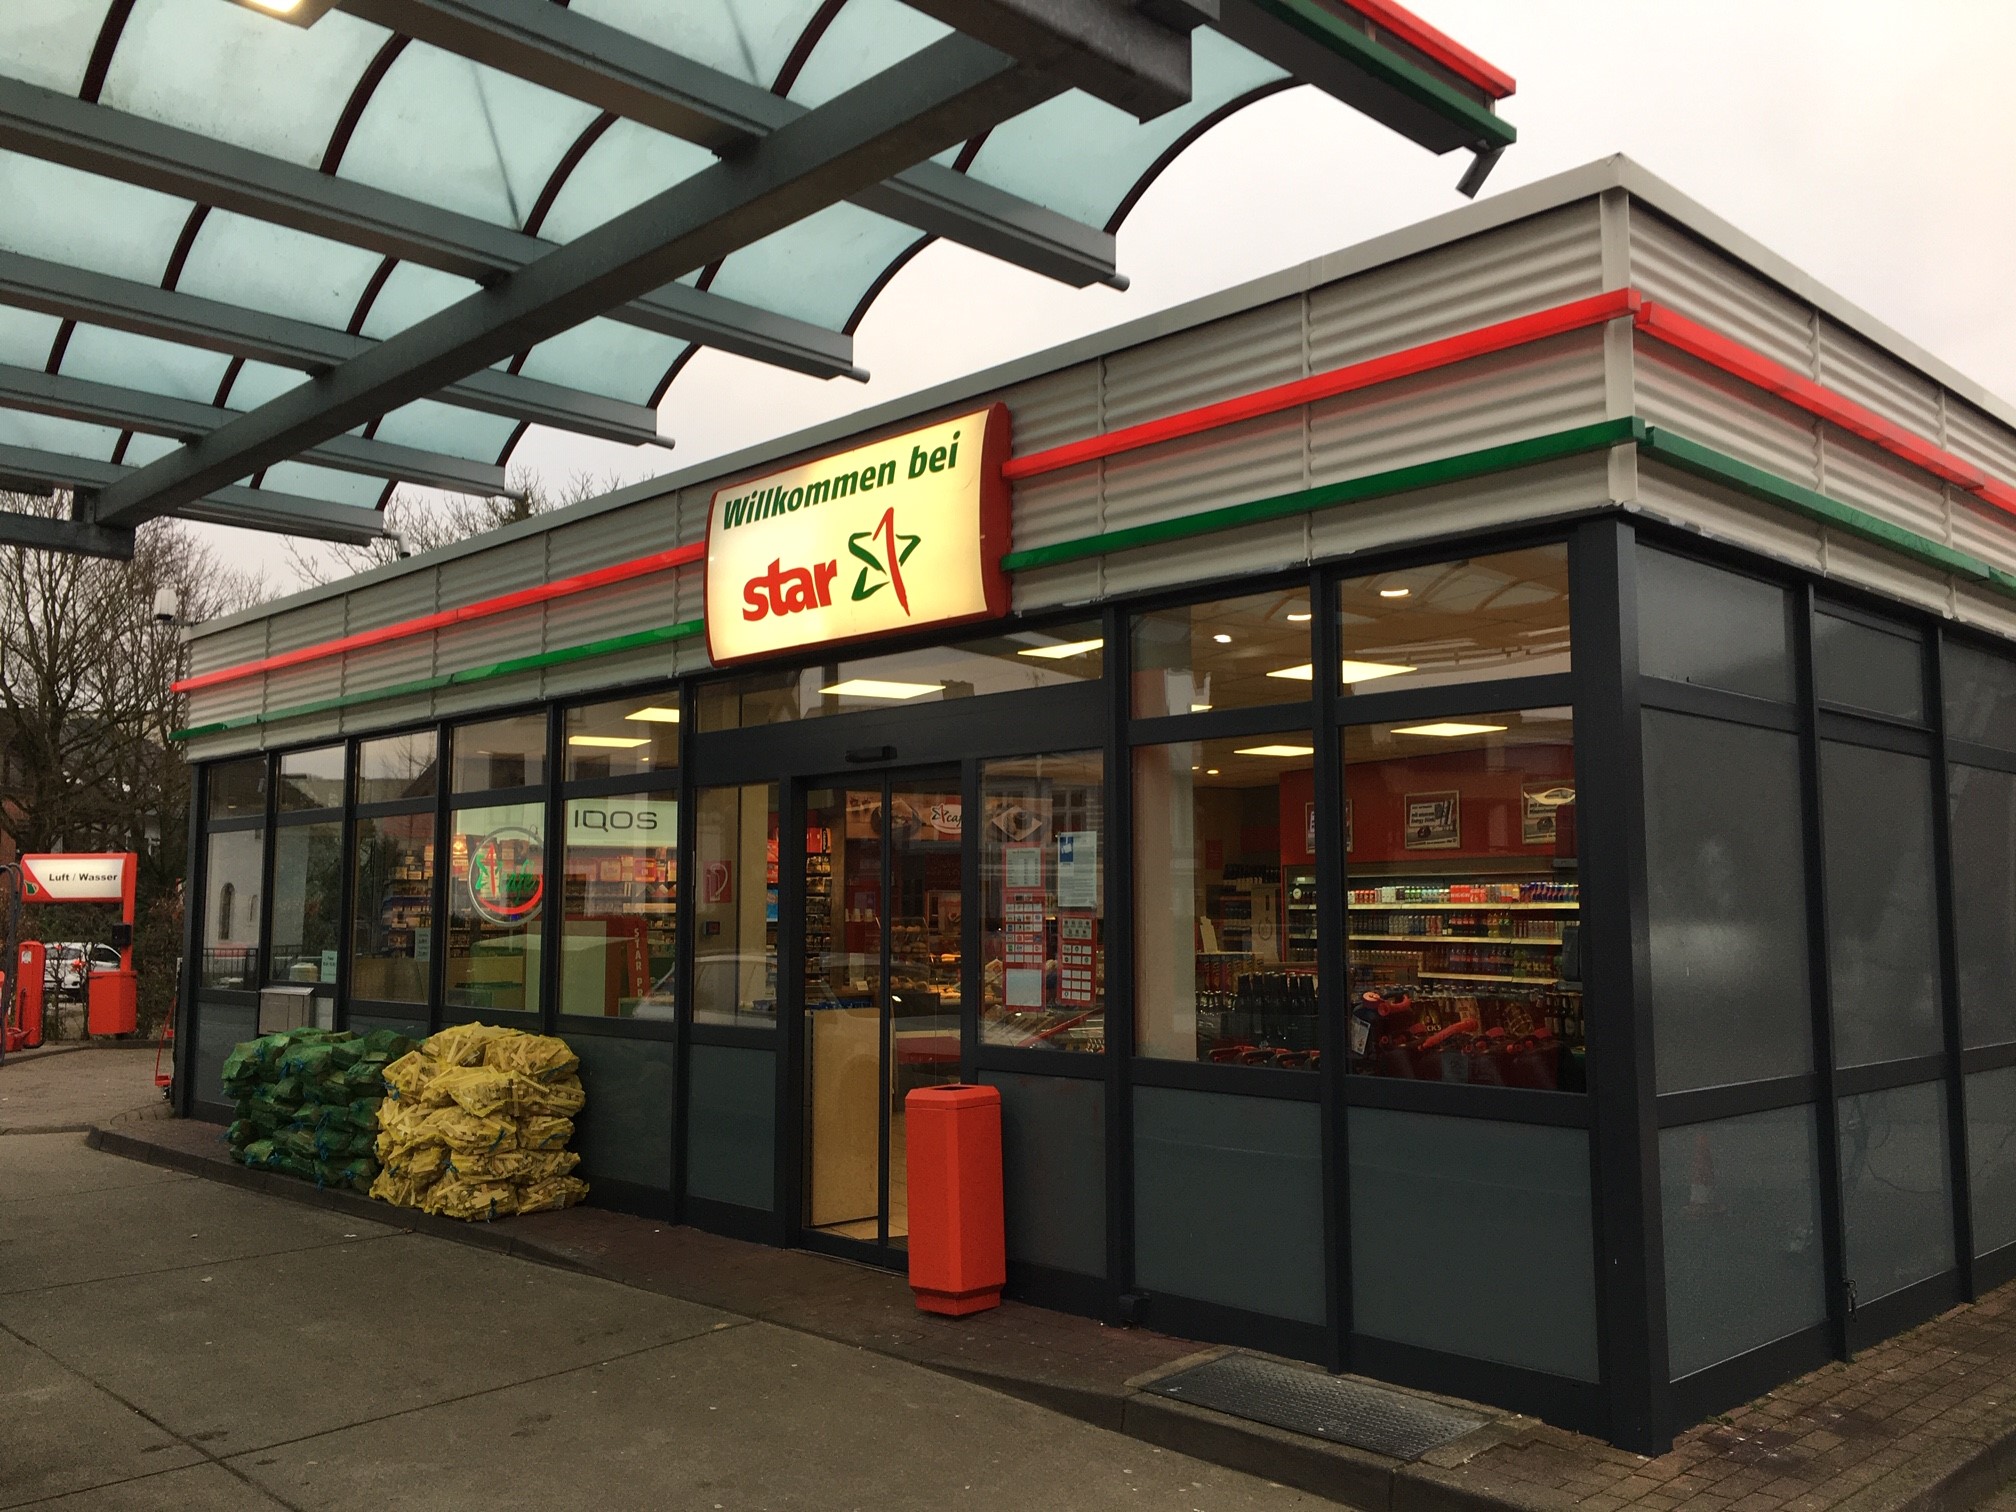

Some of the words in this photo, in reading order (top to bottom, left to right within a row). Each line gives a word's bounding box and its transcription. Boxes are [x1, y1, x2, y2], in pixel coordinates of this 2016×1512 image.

[723, 460, 897, 531] Willkommen
[908, 430, 961, 480] bei
[741, 557, 838, 622] star
[573, 809, 658, 833] IQOS
[49, 873, 70, 882] Luft
[79, 873, 118, 882] Wasser
[633, 927, 642, 972] STAR
